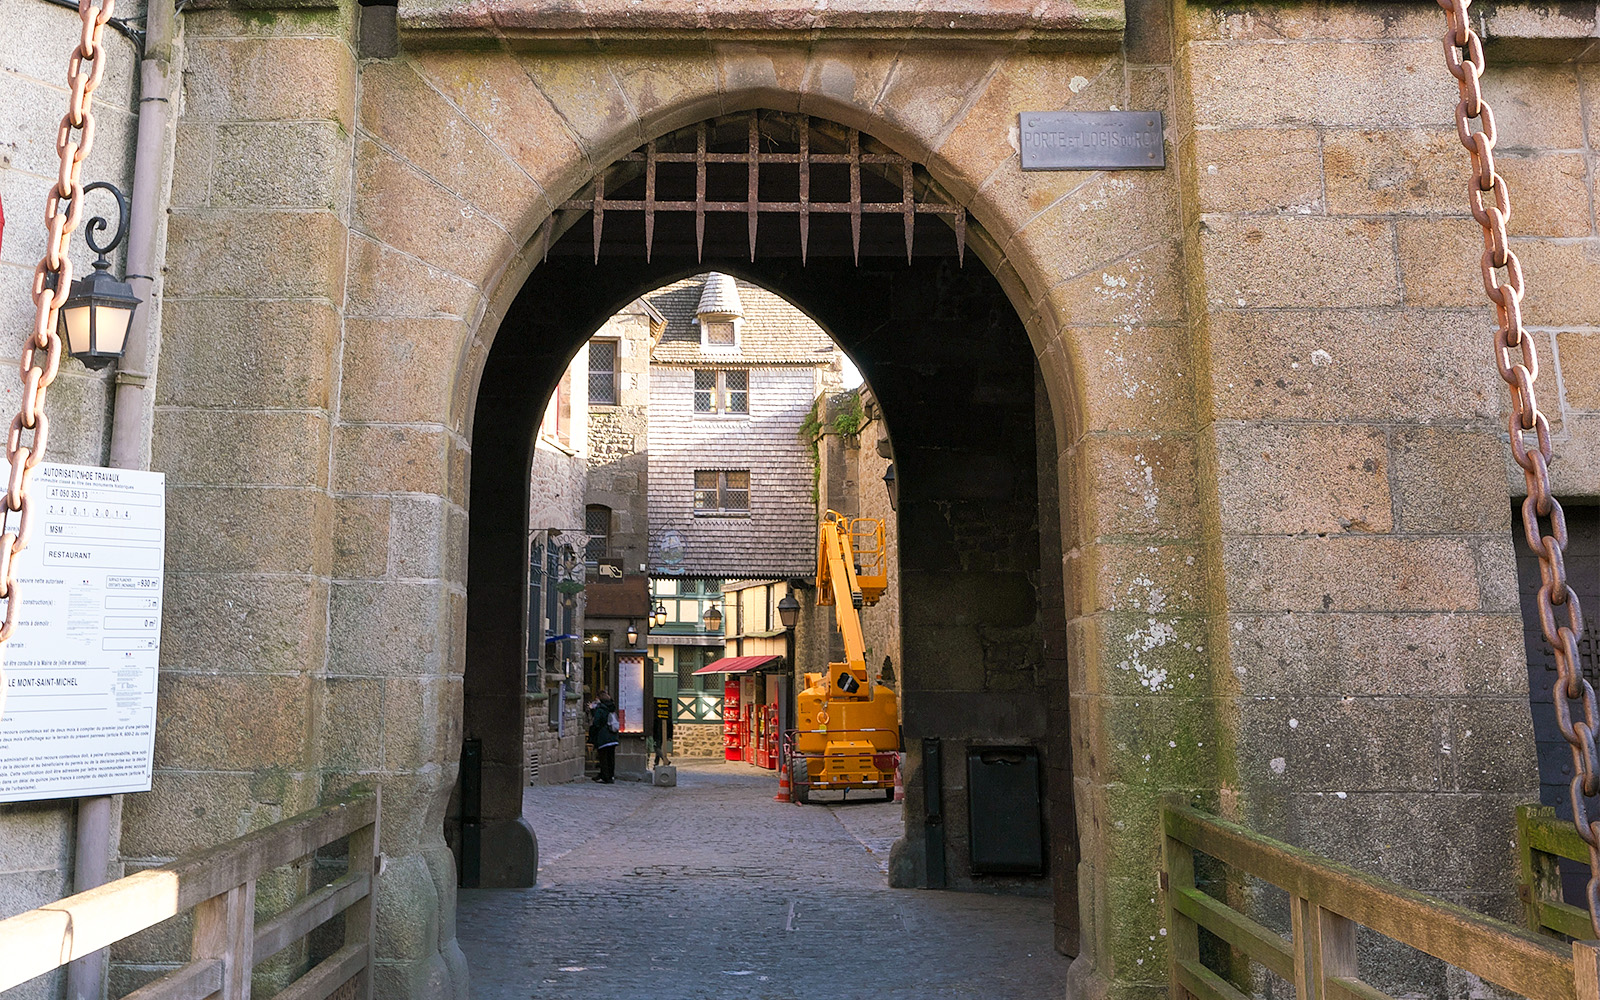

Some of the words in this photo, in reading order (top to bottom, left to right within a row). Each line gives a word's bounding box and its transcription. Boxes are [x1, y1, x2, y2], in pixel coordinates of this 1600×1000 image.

[1024, 131, 1066, 148] PORTE
[1069, 136, 1080, 146] ET
[1081, 130, 1120, 148] LOGIS
[1121, 136, 1134, 147] DU
[44, 468, 84, 480] AUTORISATION
[95, 472, 120, 482] TRAVAUX
[50, 525, 63, 534] MSM
[8, 678, 15, 687] LE
[17, 678, 78, 687] MONT-SAINT-MICHEL
